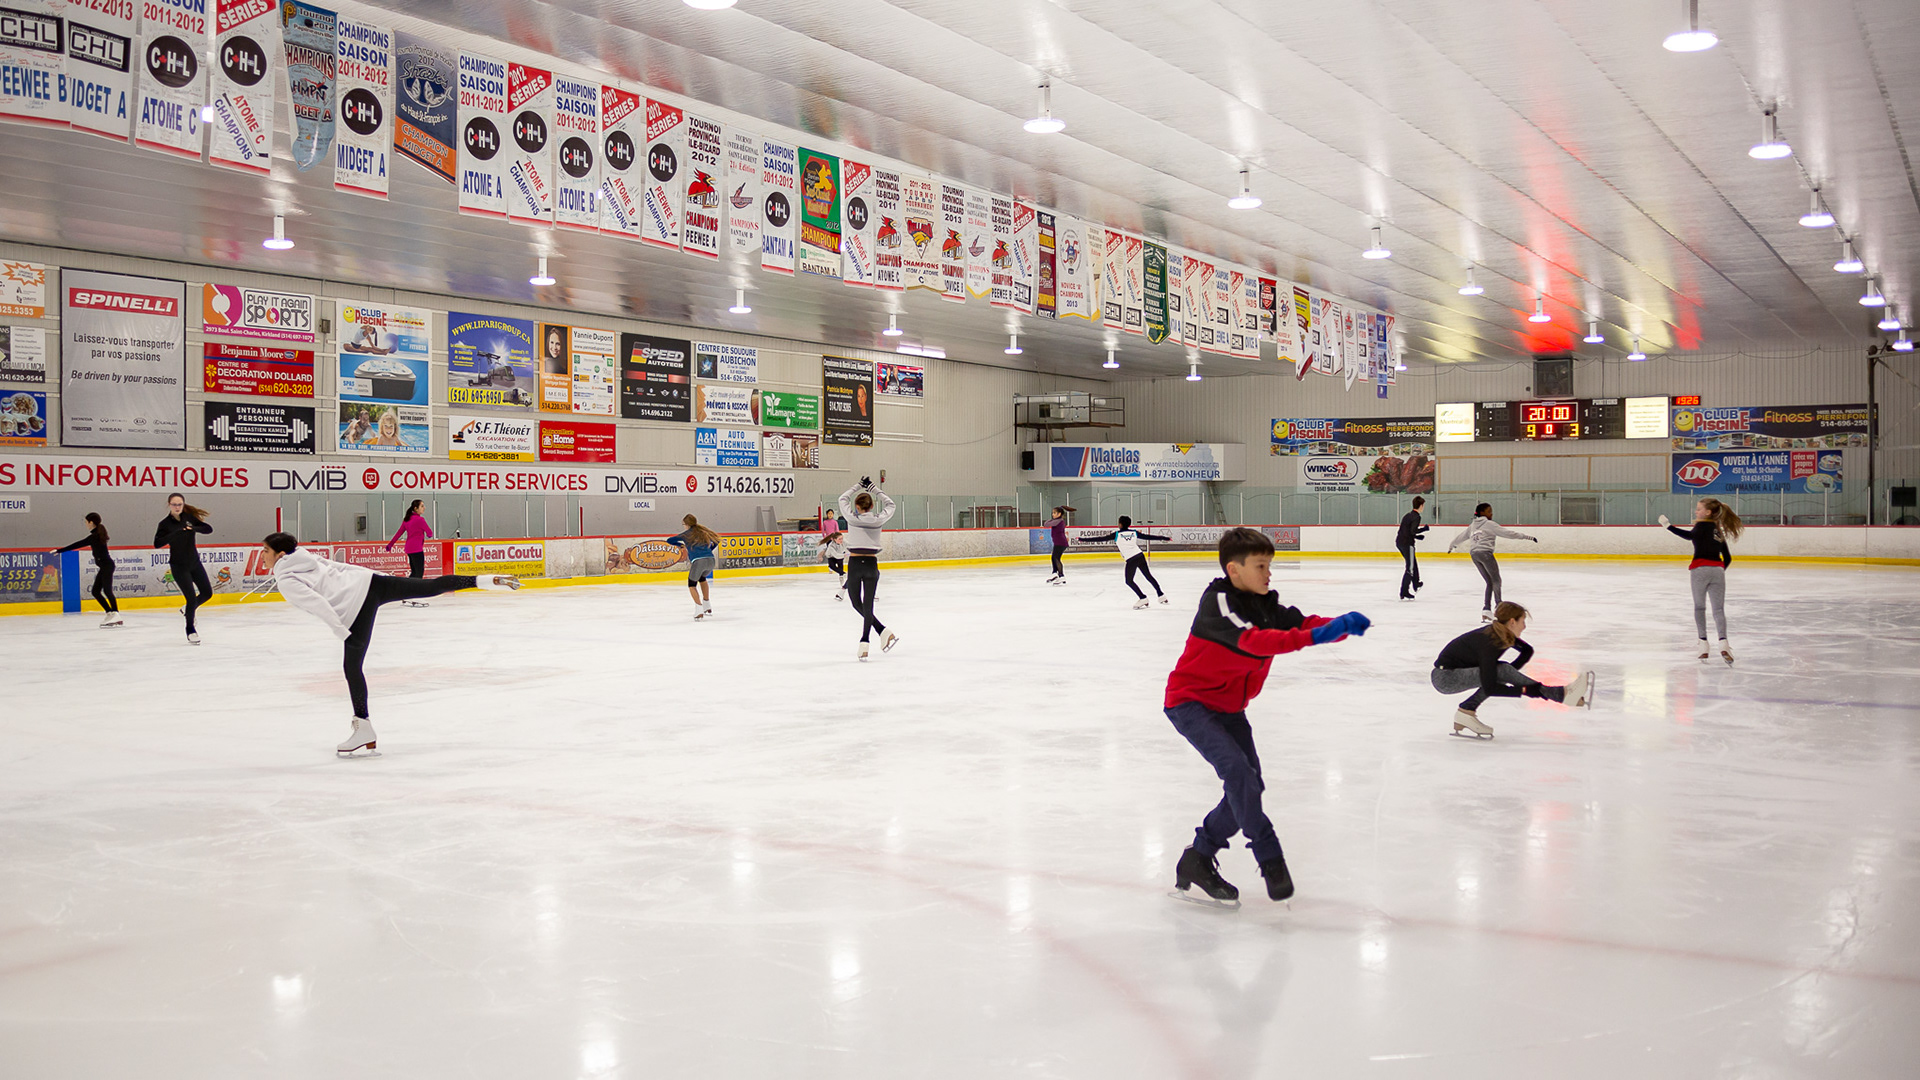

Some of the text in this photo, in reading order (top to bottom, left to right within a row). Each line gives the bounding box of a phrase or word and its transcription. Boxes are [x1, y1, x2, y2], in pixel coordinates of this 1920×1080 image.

[144, 2, 205, 35] 2011-2012
[218, 0, 268, 29] SÉRIES
[299, 8, 335, 24] Tournoi
[1, 17, 56, 44] CHL
[314, 20, 335, 32] 2012
[338, 21, 389, 49] CHAMPIONS
[71, 31, 122, 63] CHL
[338, 41, 388, 67] SAISON
[419, 55, 435, 66] 2012
[459, 55, 505, 79] CHAMPIONS
[338, 59, 388, 86] 2011-2012
[509, 66, 528, 87] 2012
[0, 65, 67, 102] EEWEE B
[460, 74, 503, 96] SAISON
[510, 75, 546, 107] SÉRIES
[460, 91, 504, 113] 2011-2012
[142, 97, 197, 135] ATOME C
[233, 94, 255, 133] ATOME
[689, 117, 721, 134] TOURNOI
[402, 124, 448, 157] CHAMPION
[689, 127, 721, 145] PROVINCIAL
[691, 151, 716, 165] 2012
[763, 142, 794, 161] CHAMPIONS
[337, 144, 386, 177] MIDGET A
[876, 170, 899, 182] TOURNOI
[463, 170, 502, 199] ATOME A
[942, 185, 964, 197] TOURNOI
[559, 187, 595, 213] ATOME B
[878, 200, 896, 210] 2011
[644, 192, 668, 239] CHAMPIONS
[685, 211, 718, 232] CHAMPIONS
[994, 225, 1009, 234] 2013
[685, 229, 717, 248] PEEWEE A
[801, 225, 838, 250] CHAMPION
[762, 234, 794, 258] BANTAM A
[802, 262, 831, 275] BANTAM
[904, 259, 939, 270] CHAMPIONS
[74, 292, 173, 313] SPINELLI
[247, 294, 308, 309] PLAY IT AGAIN
[355, 309, 387, 327] PISCINE
[361, 308, 381, 317] CLUB
[451, 320, 531, 345] WWW.LIPARIGROUP.CA
[573, 330, 613, 342] Yannie Dupont
[73, 332, 174, 351] Laissez-vous transporter
[91, 349, 161, 362] par vos passions
[220, 344, 284, 359] Benjamin Moore
[642, 348, 684, 362] SPEED
[697, 343, 756, 357] CENTRE DE SOUDURE
[647, 360, 684, 368] AUTOTECH
[720, 355, 756, 366] AUBICHON
[71, 369, 177, 386] Be driven by your passions
[217, 368, 313, 382] DECORATION DOLLARD
[258, 384, 273, 394] (514)
[273, 383, 313, 395] 620-3202
[450, 388, 469, 402] (514)
[236, 406, 286, 415] ENTRAINEUR
[1528, 407, 1570, 420] 20:00
[1704, 409, 1812, 423] CLUB Fitness
[238, 415, 284, 423] PERSONNEL
[1693, 411, 1750, 431] PISCINE
[474, 422, 493, 434] S.F.
[1288, 421, 1333, 440] PISCINE
[1297, 420, 1324, 429] CLUB
[1345, 421, 1383, 434] Fitness
[1527, 423, 1579, 437] 9 0 3
[553, 435, 574, 444] Home
[697, 432, 717, 445] A&N
[728, 431, 745, 439] AUTO
[720, 440, 755, 449] TECHNIQUE
[466, 452, 519, 460] 514-626-3881
[1090, 447, 1140, 463] Matelas
[1091, 462, 1139, 475] BONHEUR
[1307, 465, 1337, 473] WINGS
[1683, 451, 1788, 482] DQ OUVERT À L'ANNÉE
[1746, 466, 1782, 474] boul. St-Charles
[26, 464, 794, 494] INFORMATIQUES DMIB COMPUTER SERVICES DMIB.com 514.626.1520
[1144, 470, 1220, 478] 1-877-BONHEUR
[1725, 482, 1791, 491] COMMANDE L'AUTO
[1274, 530, 1297, 539] KAL
[721, 537, 780, 547] SOUDURE
[209, 552, 238, 563] PLAISIR
[350, 547, 359, 555] Le
[476, 546, 542, 560] Jean Coutu
[632, 543, 680, 558] Pâtisserie
[722, 548, 761, 557] BOUDREAU
[12, 555, 38, 568] PATINS
[349, 555, 406, 566] d'aménagement
[726, 557, 777, 567] 514-944-6113
